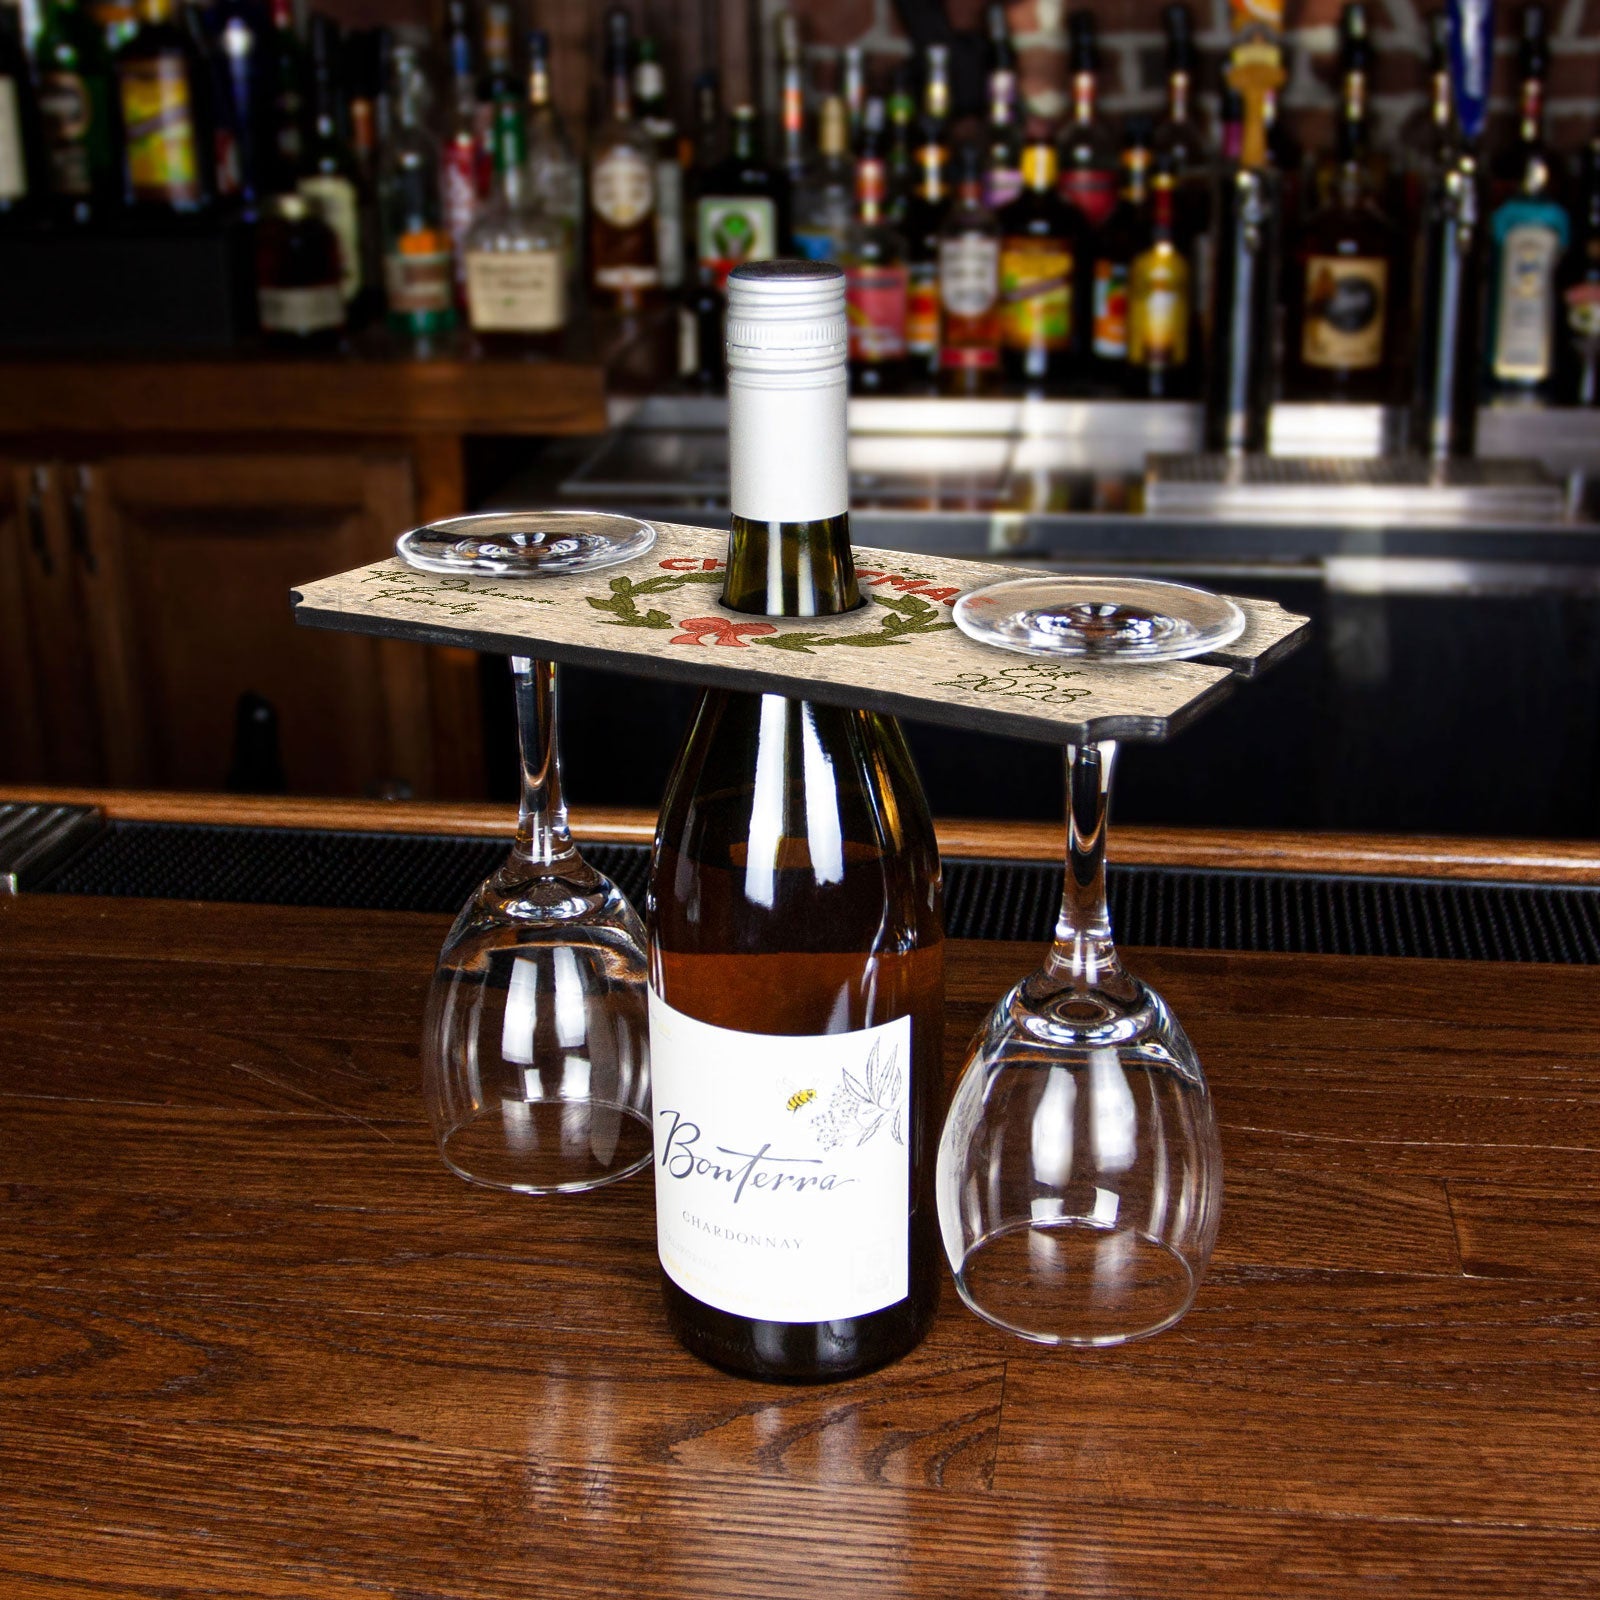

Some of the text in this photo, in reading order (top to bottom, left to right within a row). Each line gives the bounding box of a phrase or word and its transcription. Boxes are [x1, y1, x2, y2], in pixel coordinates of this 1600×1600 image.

[360, 570, 562, 606] The Johnson
[367, 588, 483, 616] Family
[931, 673, 1092, 704] 2023
[659, 1109, 856, 1204] Bonterra
[682, 1210, 803, 1250] CHARDONNAY
